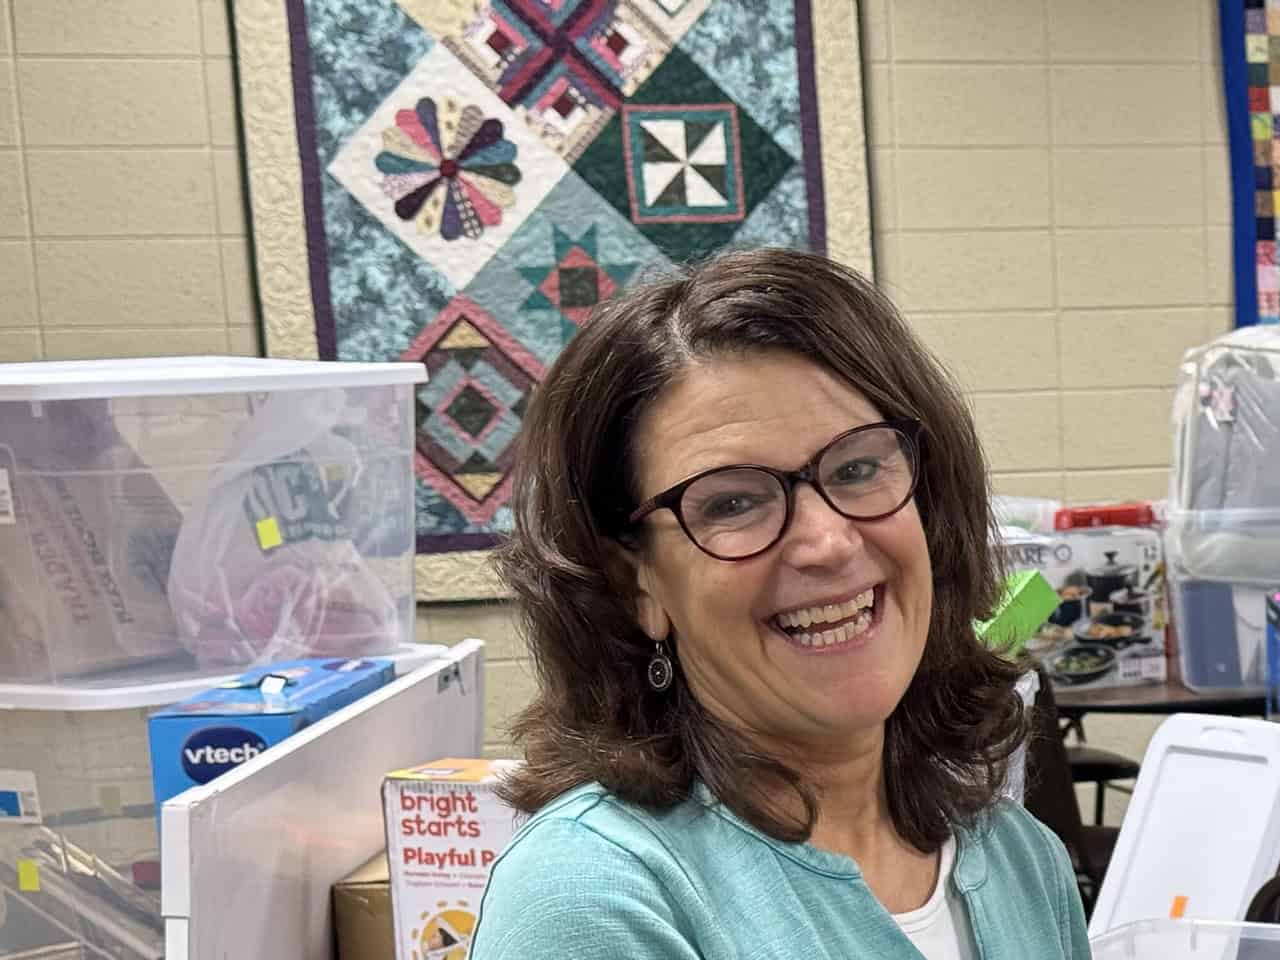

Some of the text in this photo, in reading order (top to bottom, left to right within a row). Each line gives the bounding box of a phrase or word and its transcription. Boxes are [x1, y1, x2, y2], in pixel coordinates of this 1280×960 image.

[400, 789, 478, 819] bright
[401, 813, 481, 838] starts
[403, 848, 475, 869] Playful
